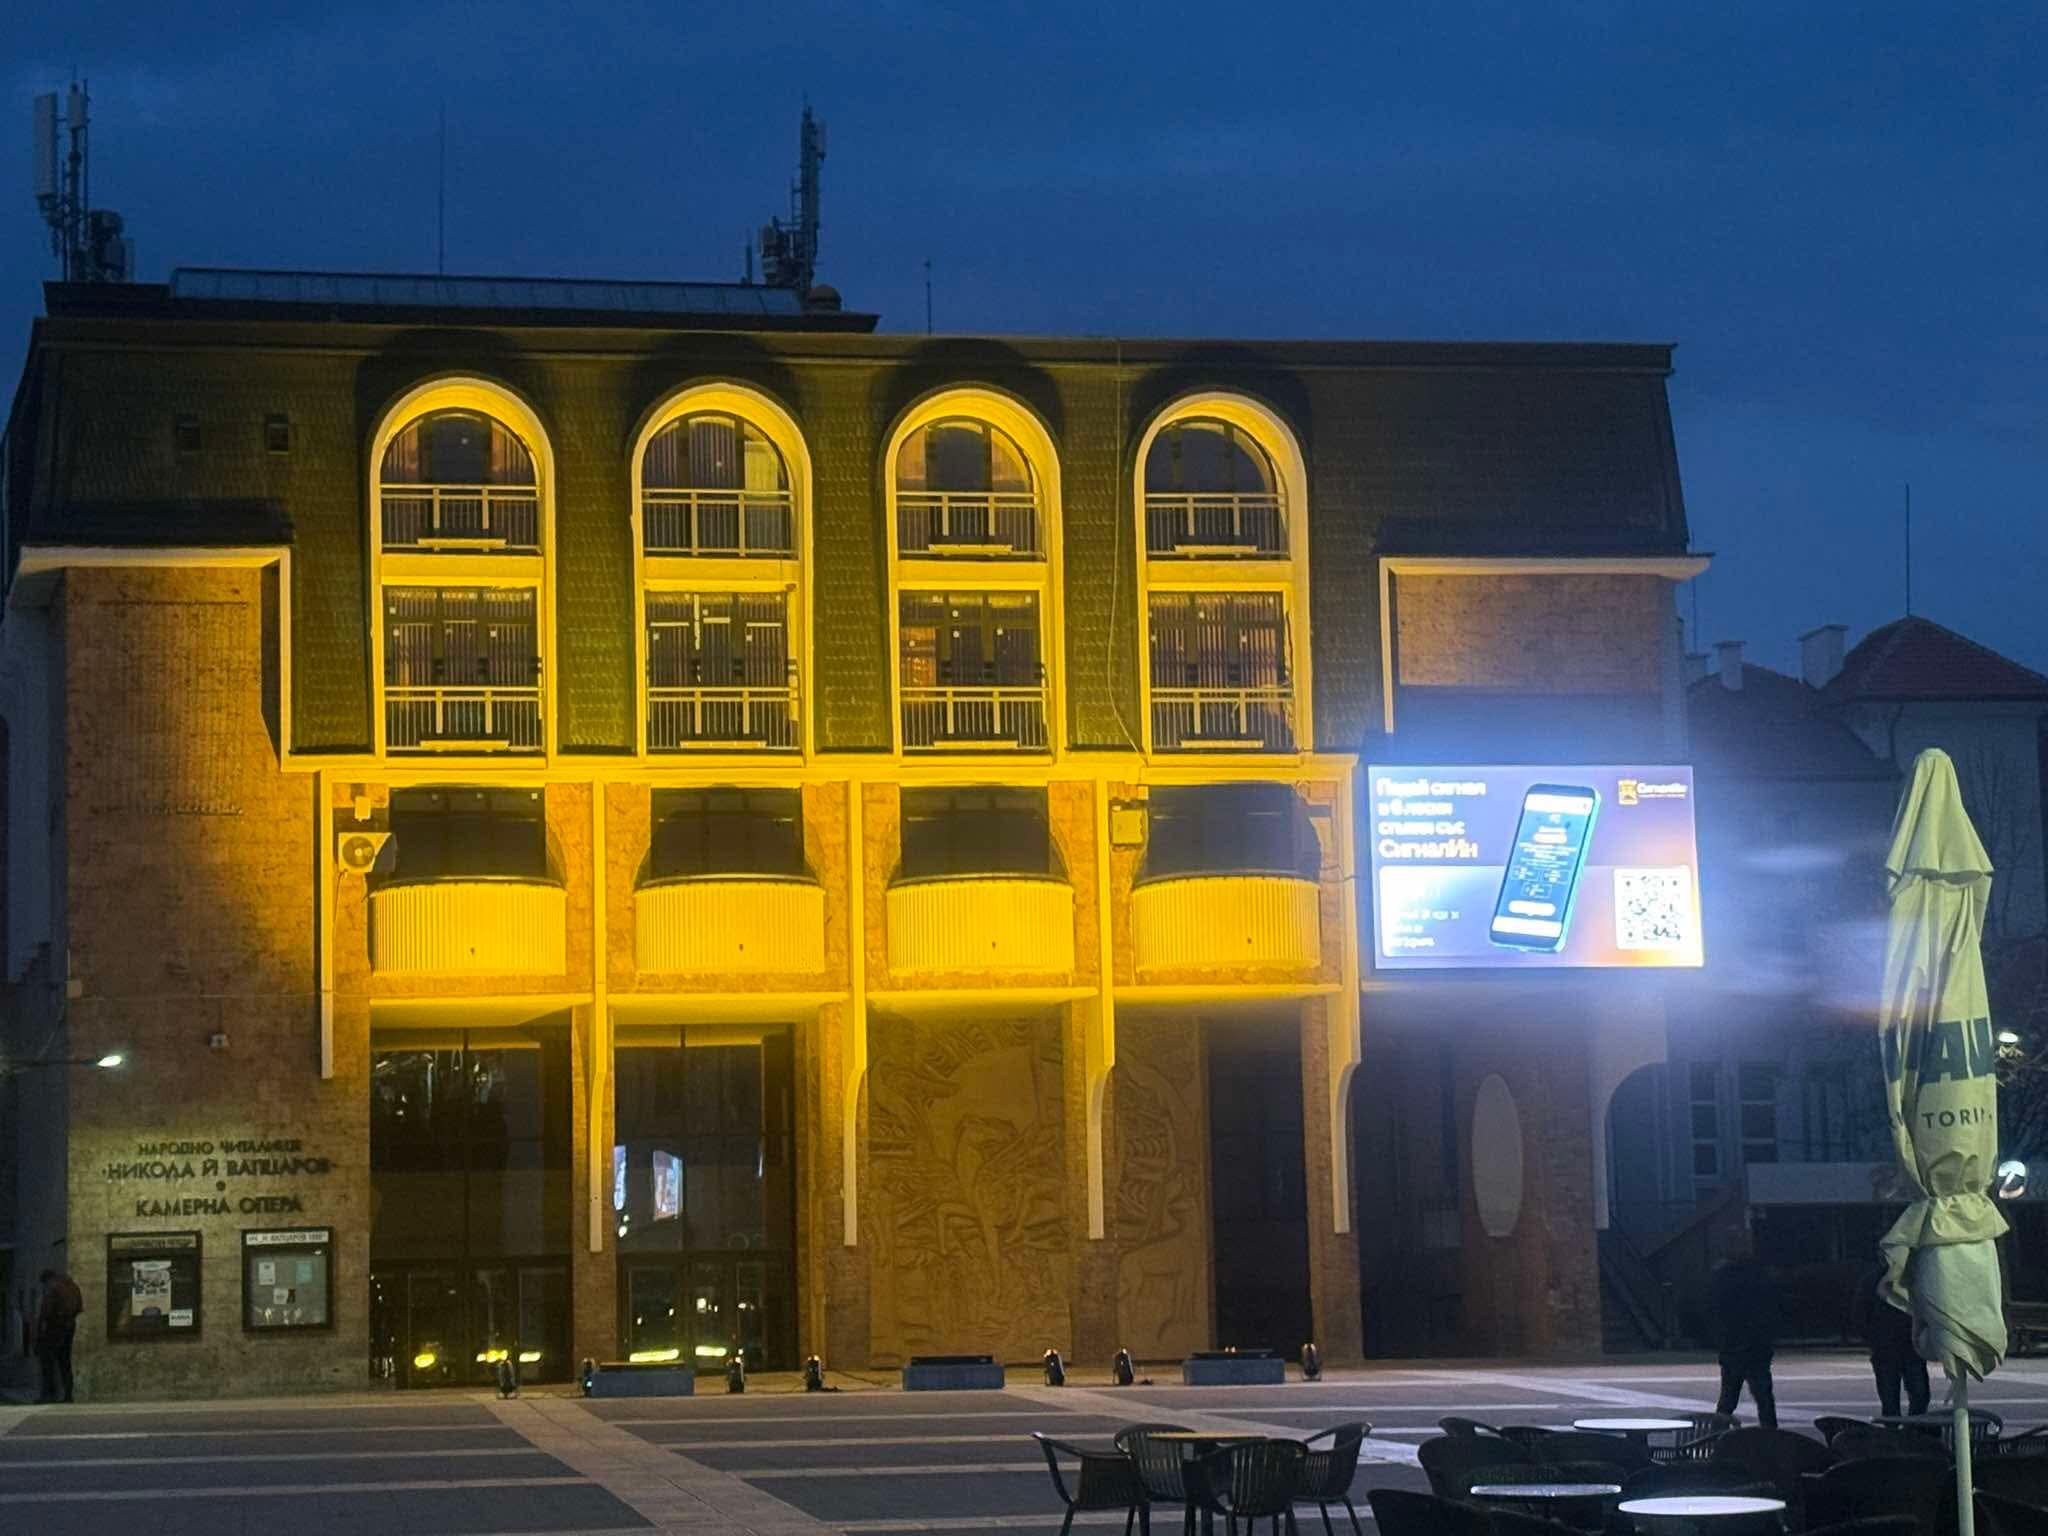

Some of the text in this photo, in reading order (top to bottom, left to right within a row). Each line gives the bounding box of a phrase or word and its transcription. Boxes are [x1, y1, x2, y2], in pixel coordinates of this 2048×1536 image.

[138, 1142, 214, 1156] НАРОДНО
[136, 1195, 303, 1217] КАМЕРНА ОПЕРА
